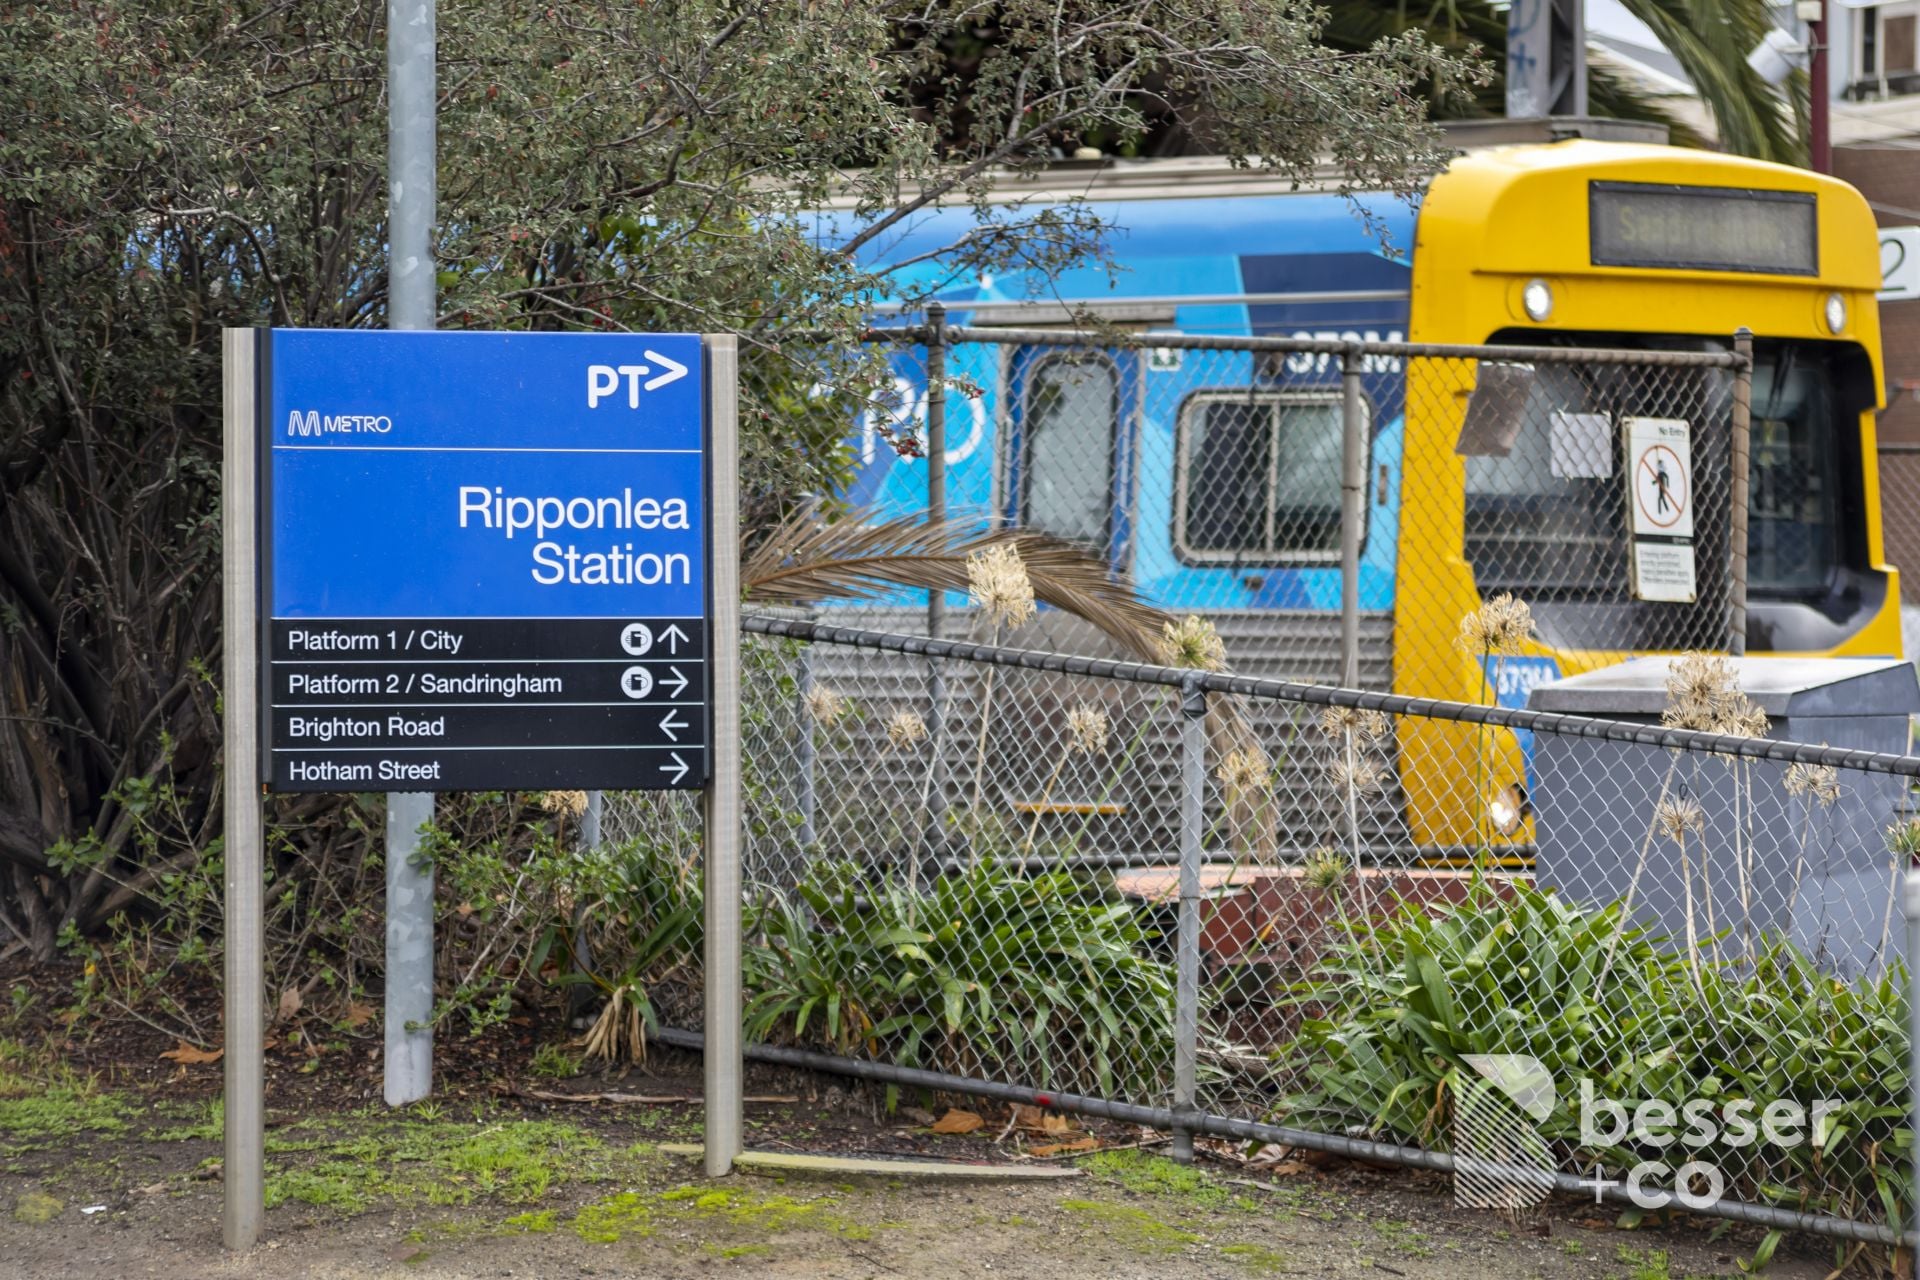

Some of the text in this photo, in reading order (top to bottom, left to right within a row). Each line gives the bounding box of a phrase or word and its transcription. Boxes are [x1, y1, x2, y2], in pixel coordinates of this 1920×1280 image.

[324, 416, 391, 432] METRO
[460, 486, 689, 538] Ripponlea
[532, 542, 690, 584] Station
[289, 631, 378, 650] Platform
[387, 631, 395, 649] 1
[421, 630, 462, 654] City
[290, 674, 379, 693] Platform
[386, 674, 399, 693] 2
[421, 674, 561, 697] Sandringham
[290, 716, 444, 741] Brighton Road
[290, 760, 440, 780] Hotham Street
